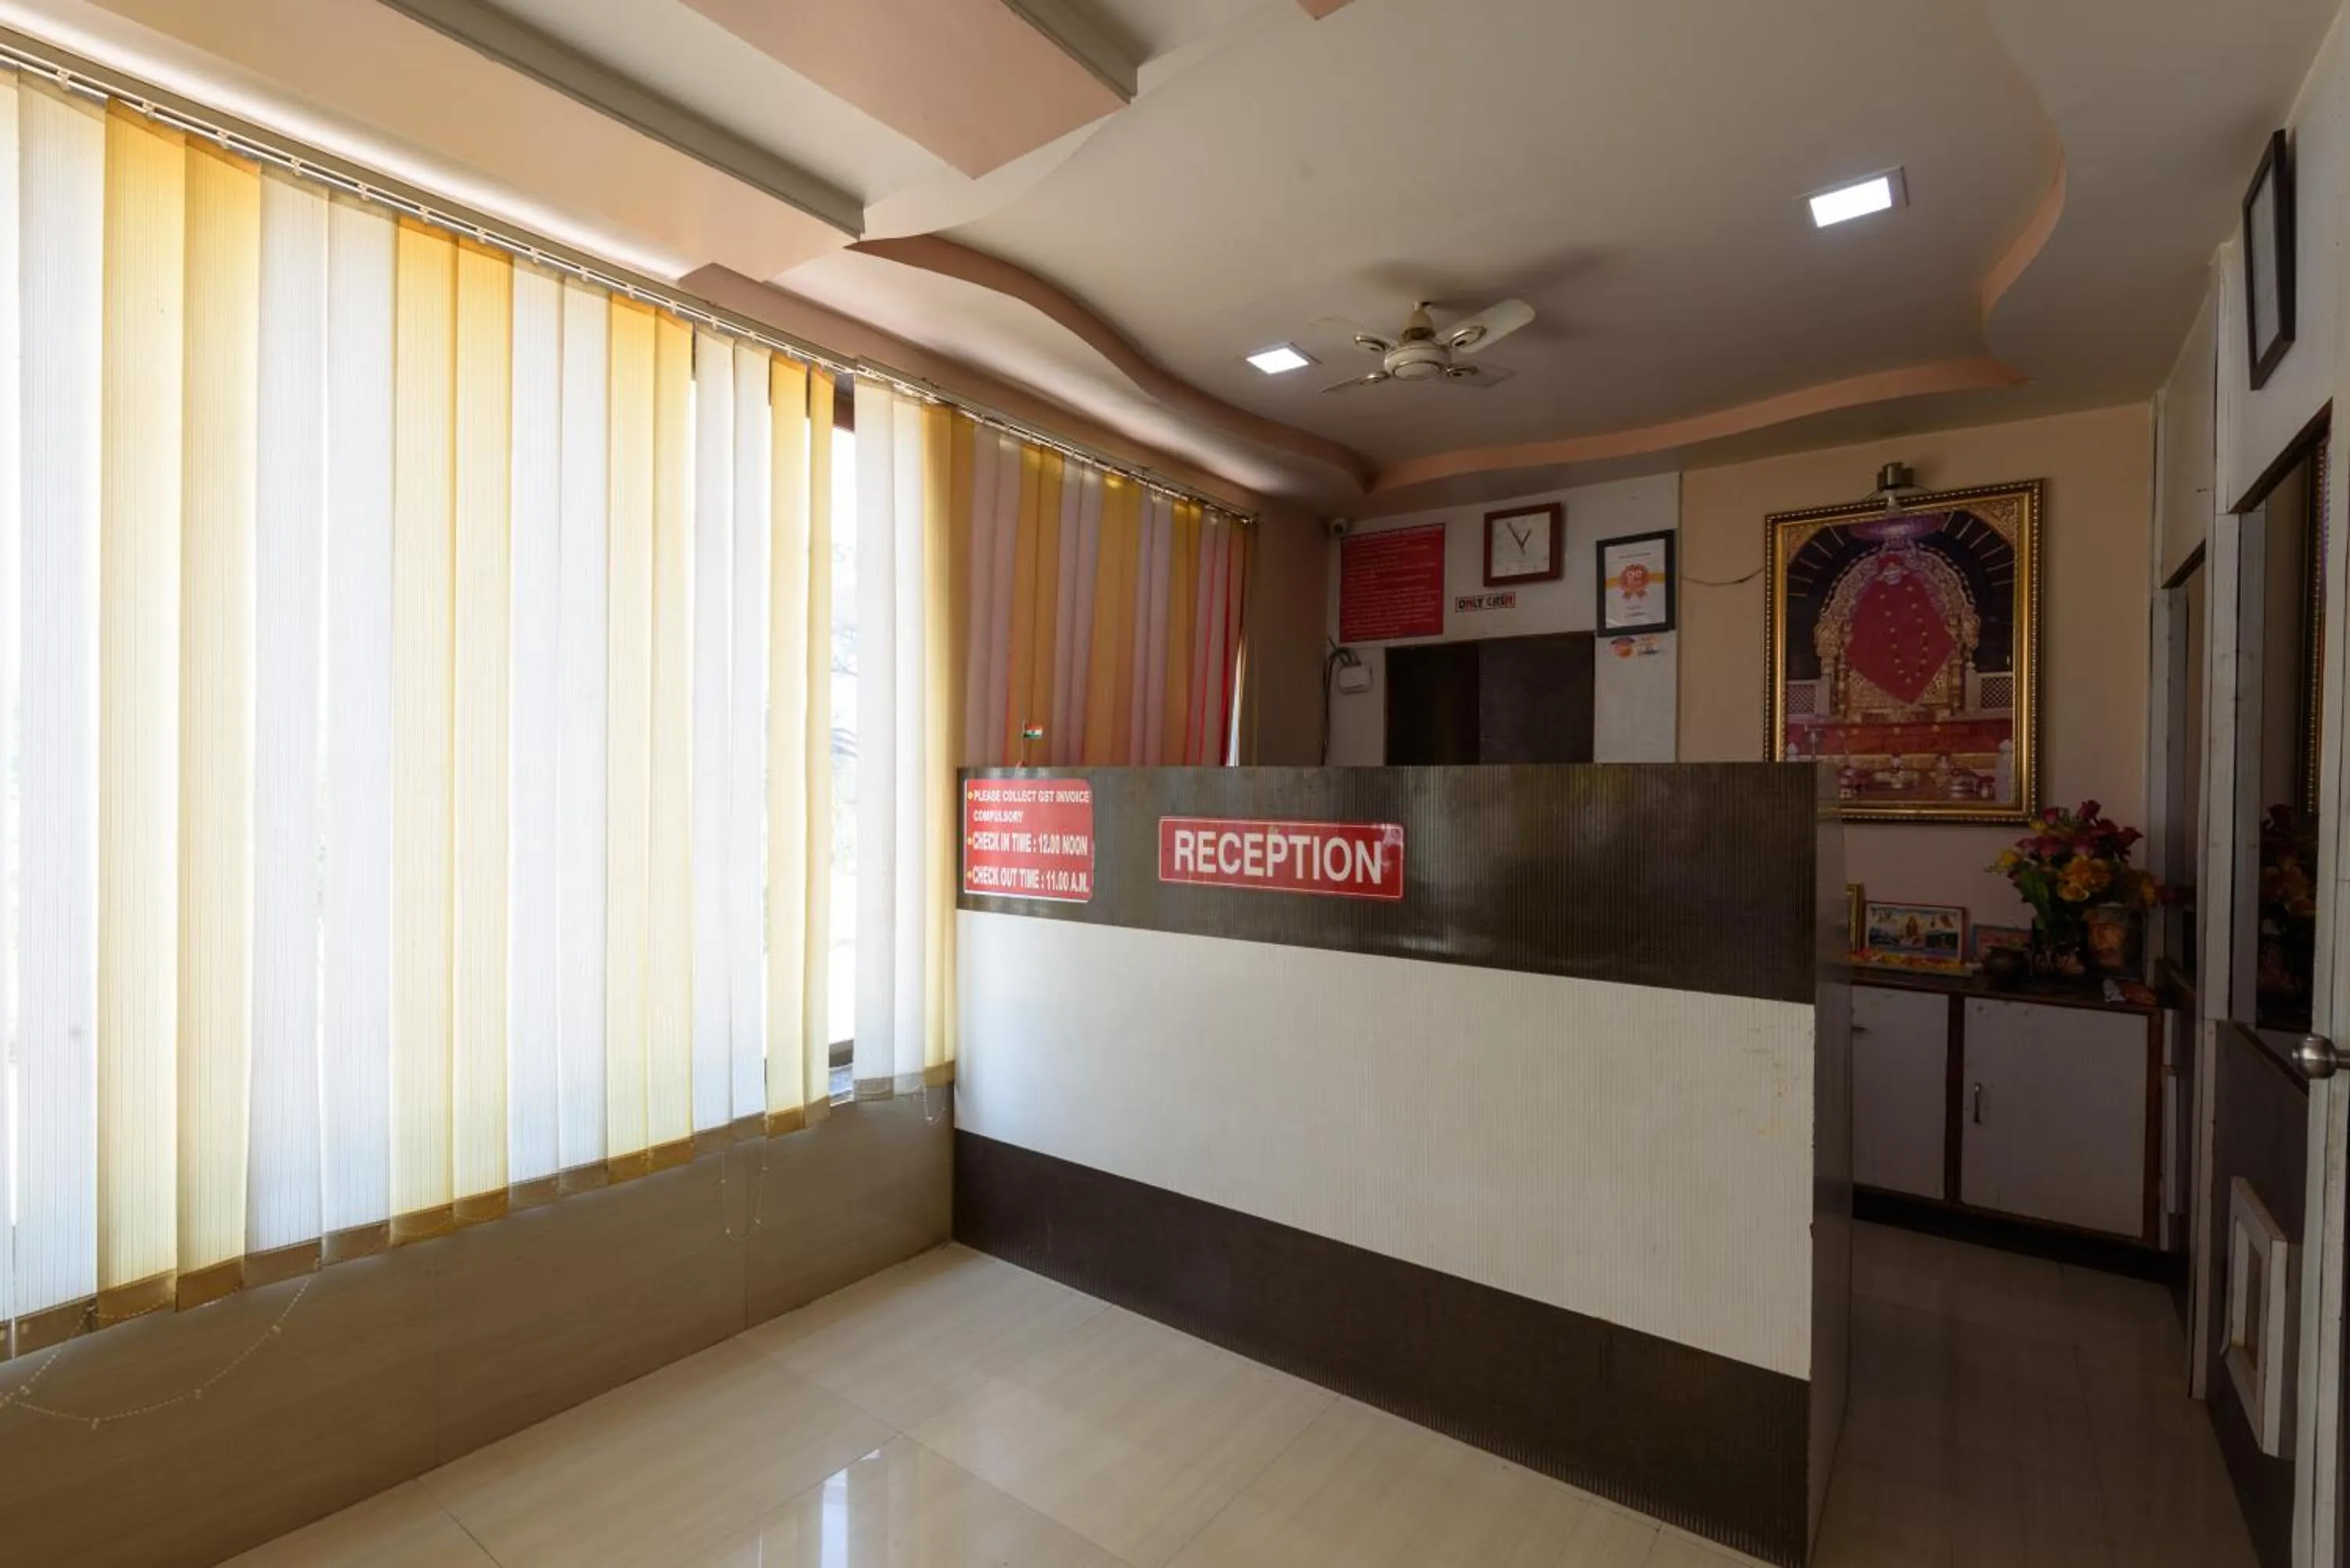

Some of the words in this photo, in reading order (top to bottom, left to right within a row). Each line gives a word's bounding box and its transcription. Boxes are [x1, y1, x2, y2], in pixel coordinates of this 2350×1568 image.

[973, 789, 1001, 802] PLEASE
[1003, 790, 1036, 803] COLLECT
[1038, 790, 1055, 803] GST
[1056, 790, 1090, 803] INVOICE
[973, 810, 1024, 823] COMPULSORY
[972, 831, 1000, 851] CHECK
[1001, 833, 1010, 852] IN
[1039, 833, 1061, 854] 12.00
[1061, 836, 1089, 856] NOON
[1174, 829, 1383, 884] RECEPTION
[972, 865, 1000, 886] CHECK
[1000, 867, 1018, 887] OUT
[1046, 870, 1070, 891] 11.00
[1071, 872, 1090, 893] A.M.
